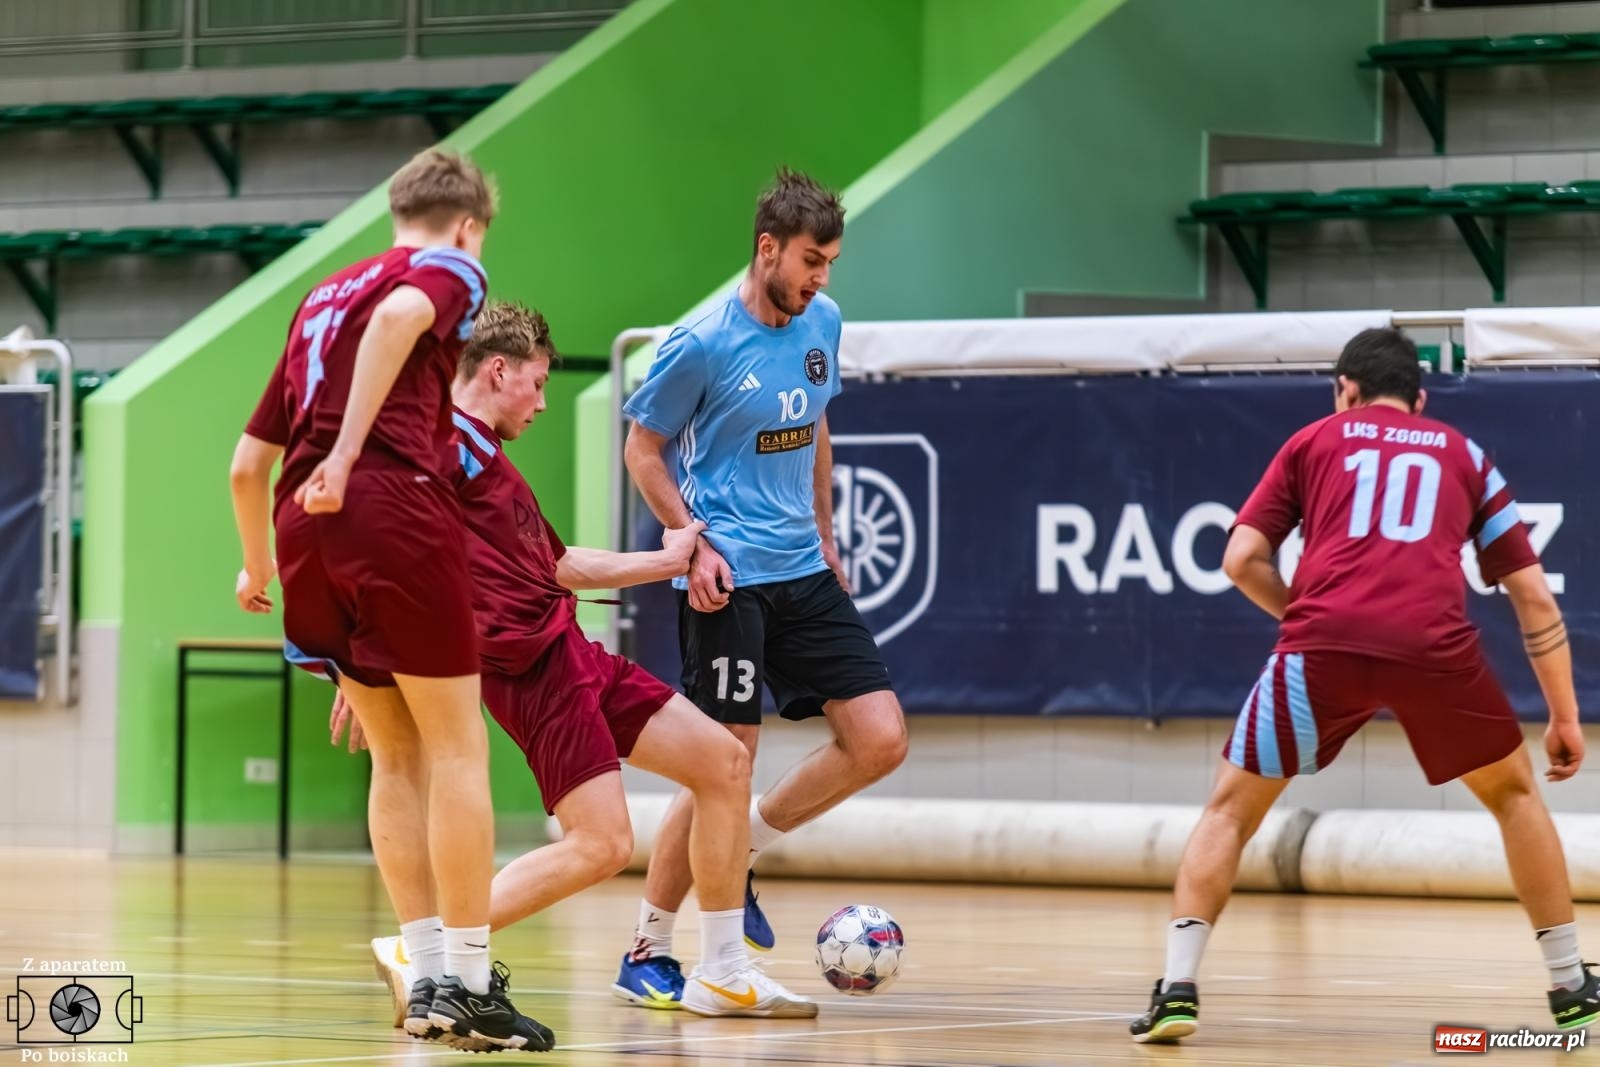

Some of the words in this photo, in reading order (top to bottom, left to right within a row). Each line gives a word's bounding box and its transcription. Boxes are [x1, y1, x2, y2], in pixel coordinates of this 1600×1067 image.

[777, 387, 808, 423] 10
[1343, 422, 1378, 439] LKS
[1383, 427, 1447, 448] ZGODA
[1343, 448, 1442, 543] 10
[711, 656, 756, 702] 13
